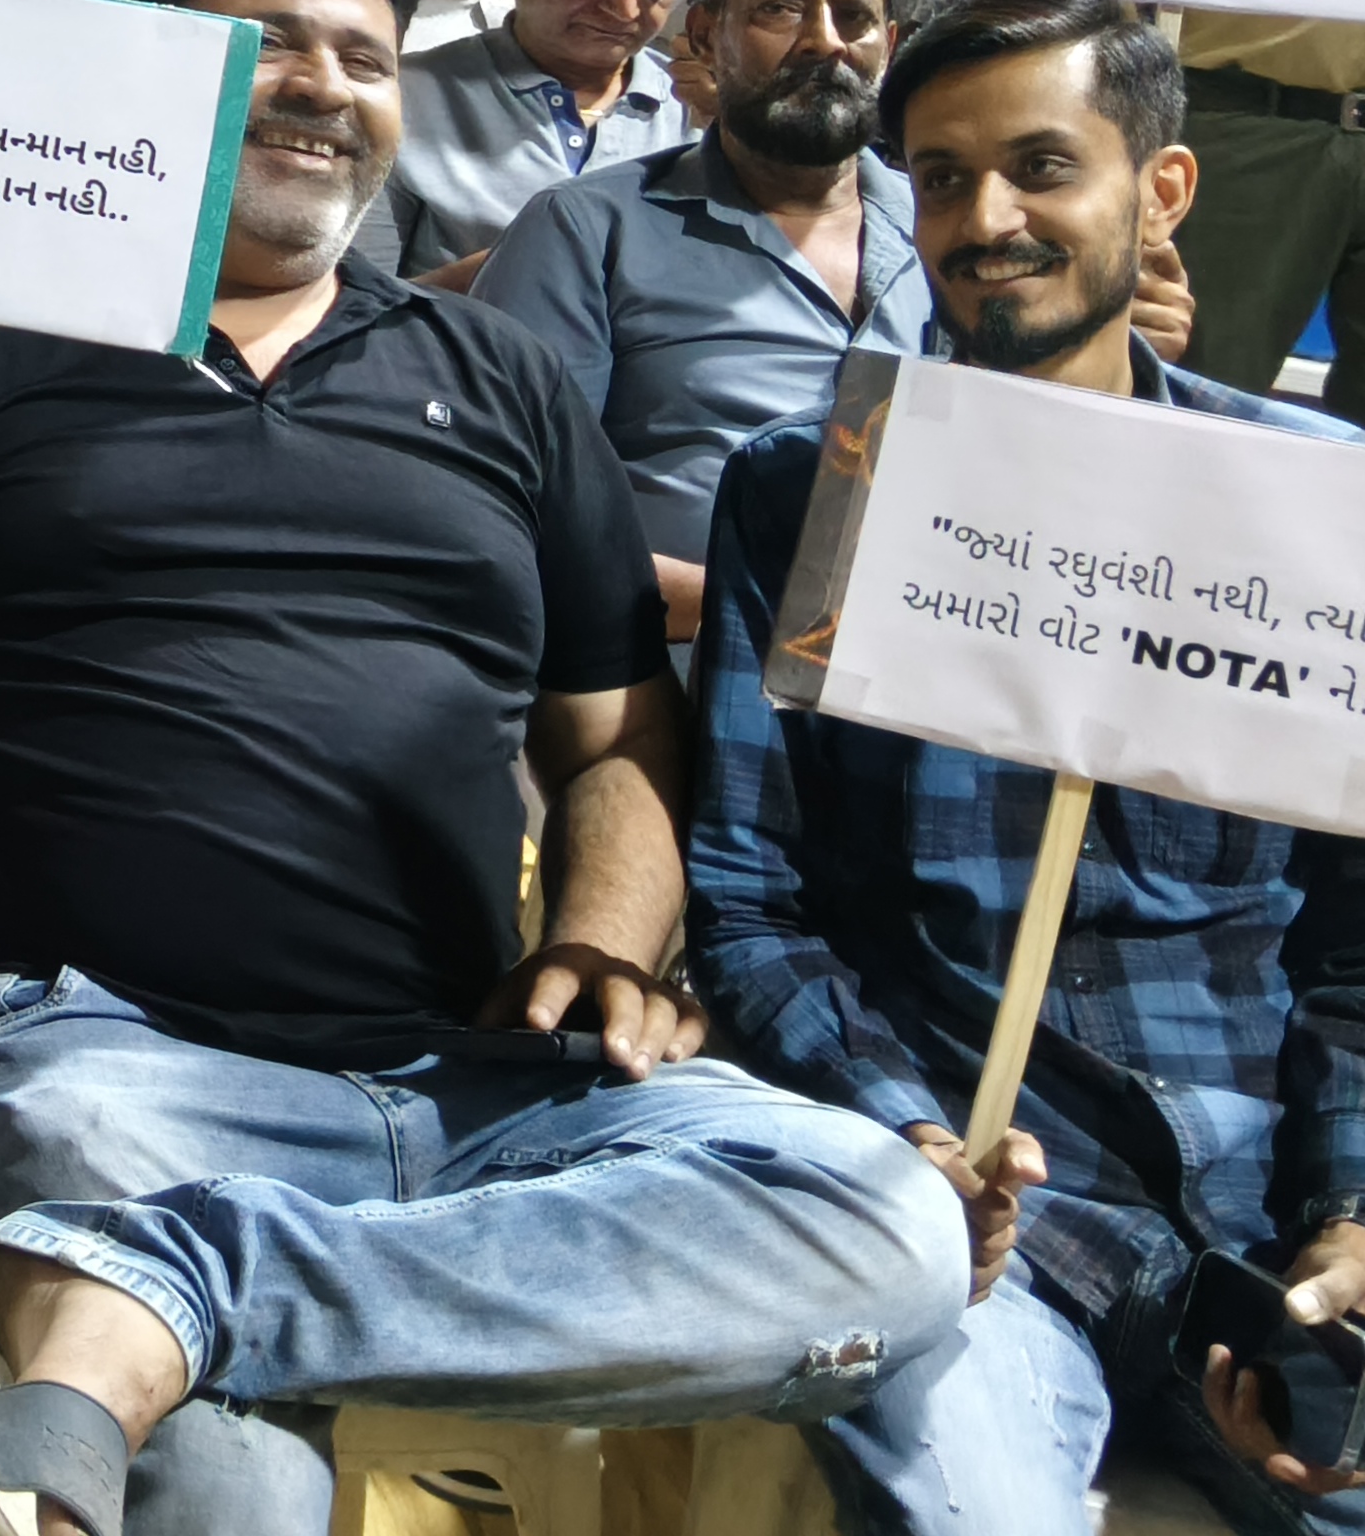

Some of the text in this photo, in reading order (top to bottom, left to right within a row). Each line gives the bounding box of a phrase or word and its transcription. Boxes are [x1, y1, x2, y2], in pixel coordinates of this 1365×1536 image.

[94, 138, 166, 182] નહી,
[45, 179, 128, 222] નહી..
[933, 516, 1280, 631] "જ્યાં રઘુવંશી નથી,
[903, 583, 1310, 698] અમારો વોટ 'NOTA'
